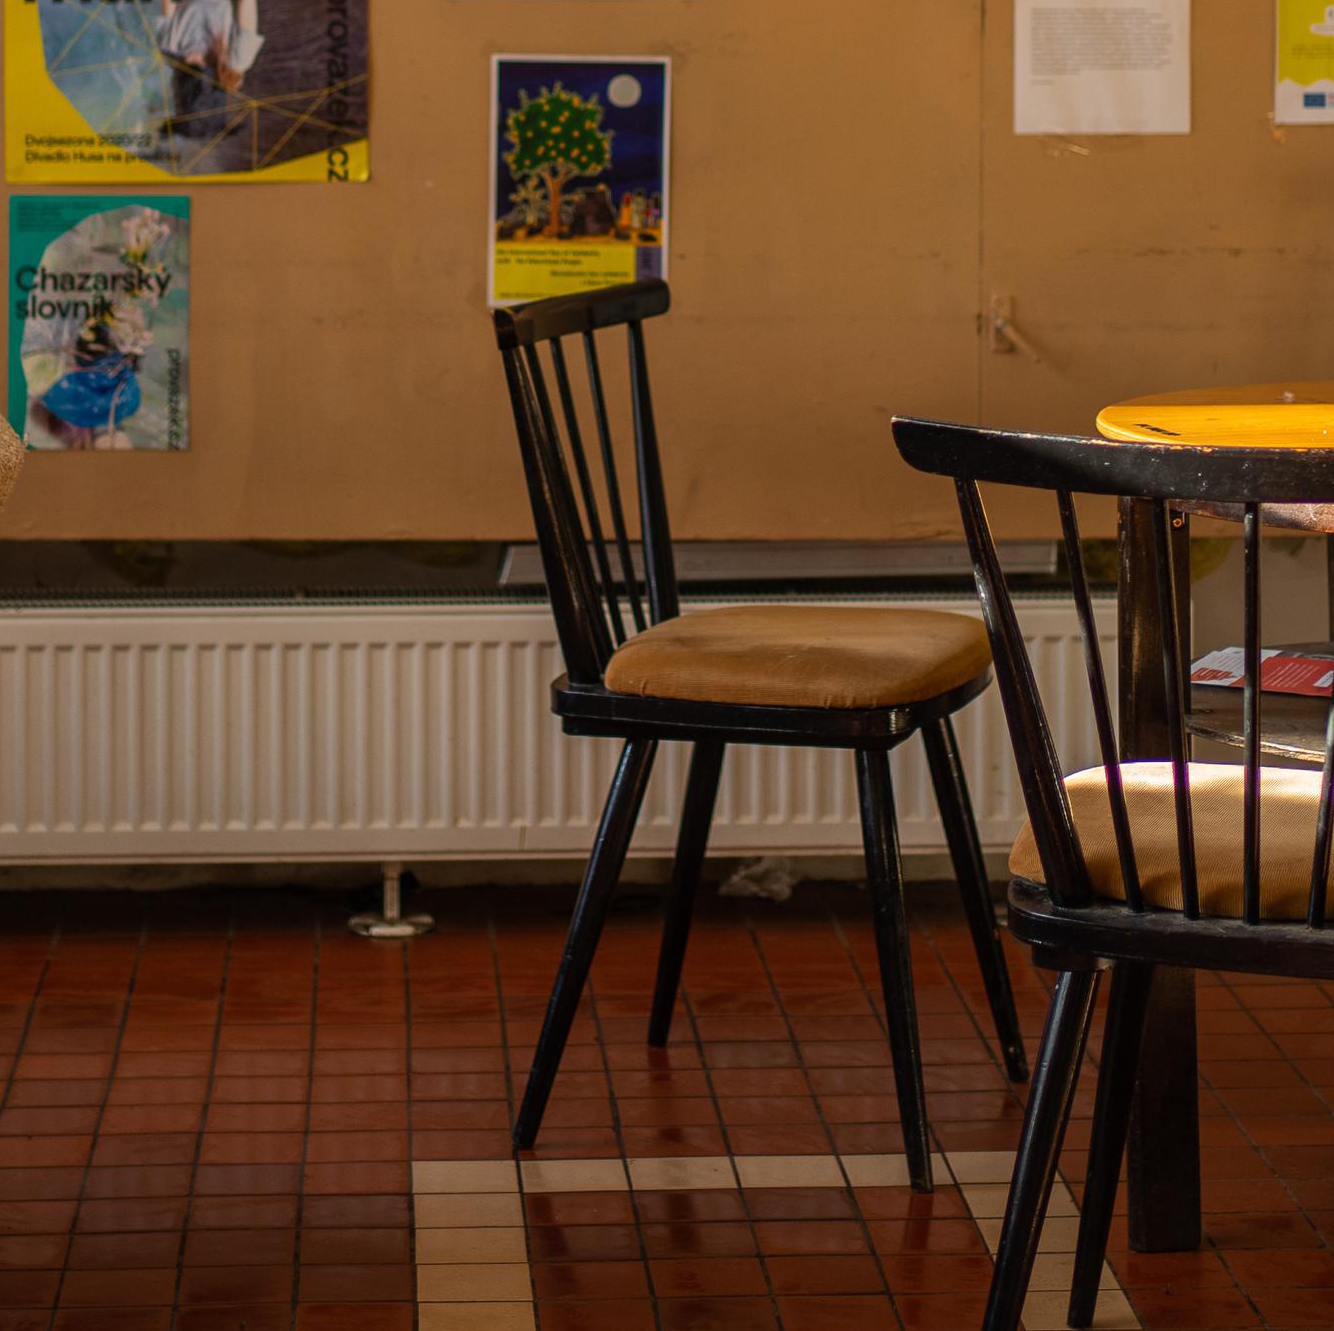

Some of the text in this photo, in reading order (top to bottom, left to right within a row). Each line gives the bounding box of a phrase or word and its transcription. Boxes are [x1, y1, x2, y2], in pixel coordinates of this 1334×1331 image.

[25, 149, 71, 163] Divadlo
[106, 152, 122, 163] na
[15, 294, 116, 320] slovník
